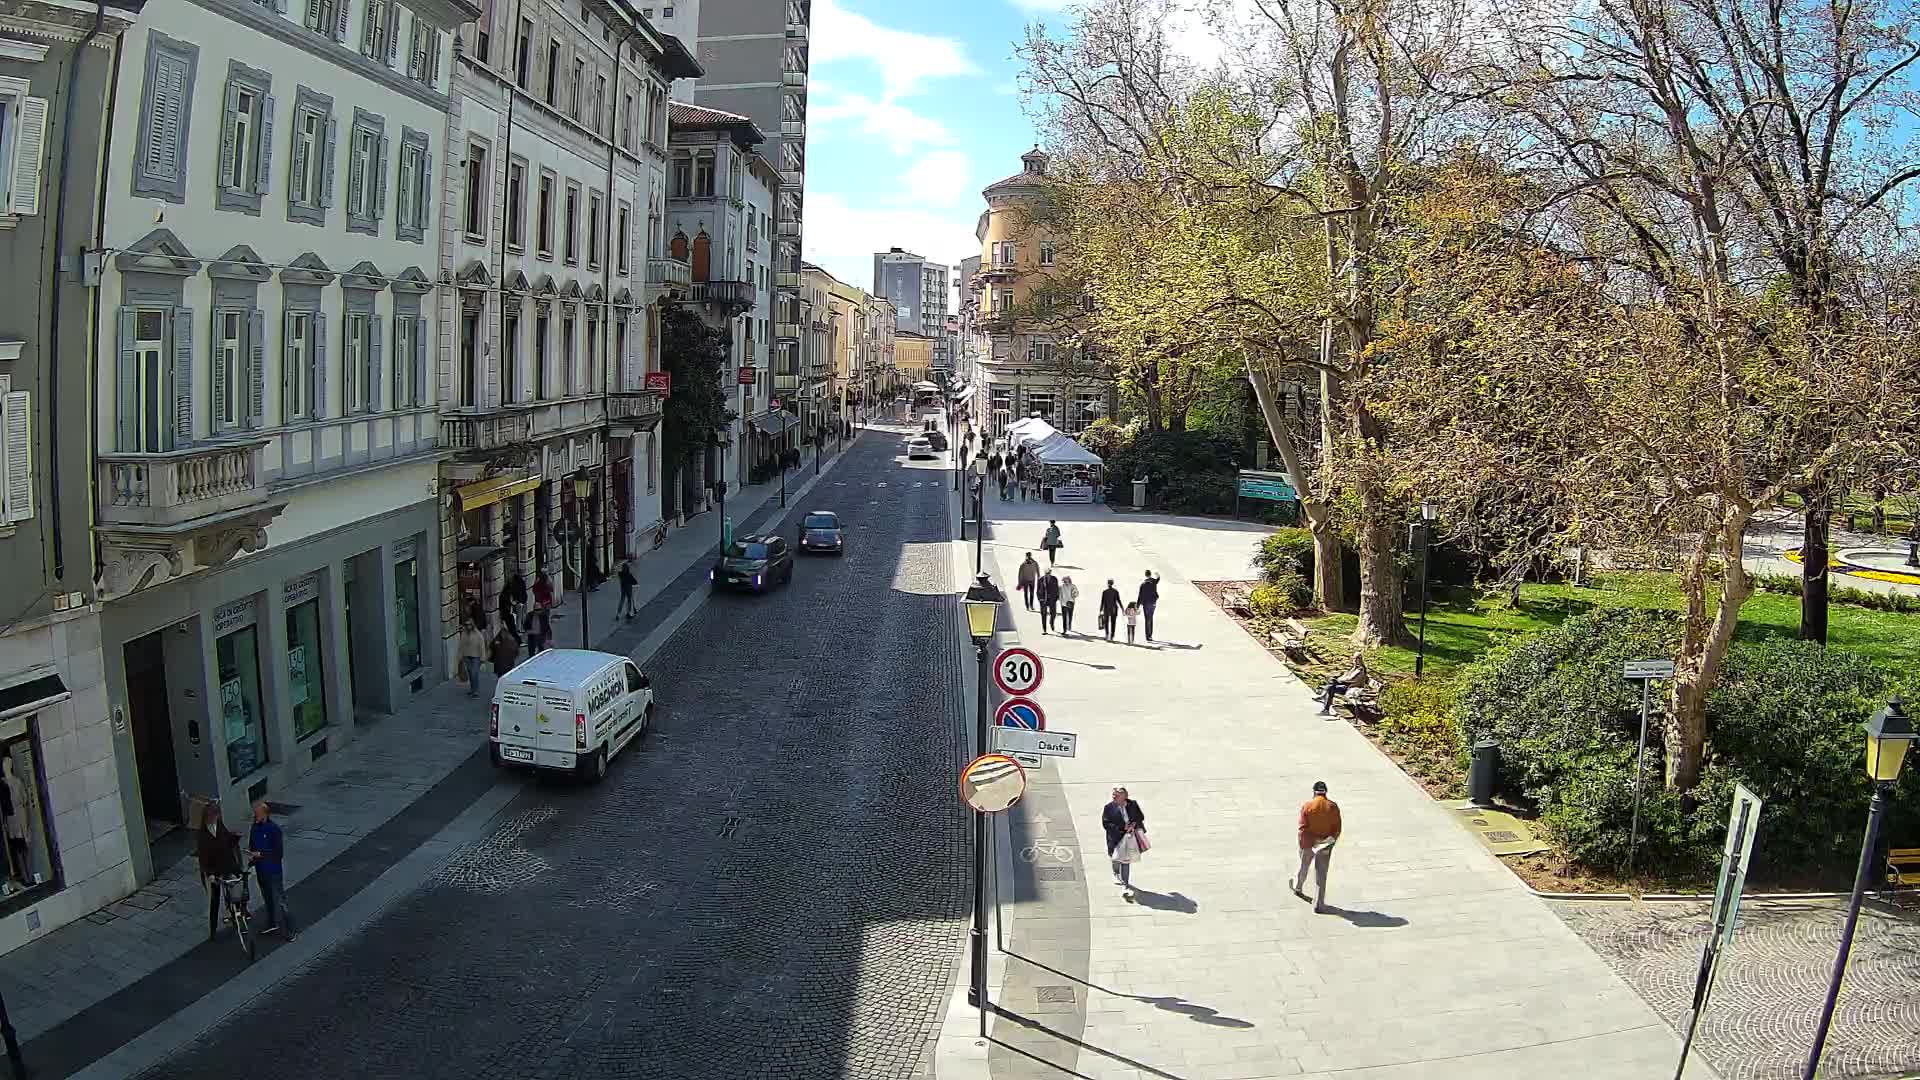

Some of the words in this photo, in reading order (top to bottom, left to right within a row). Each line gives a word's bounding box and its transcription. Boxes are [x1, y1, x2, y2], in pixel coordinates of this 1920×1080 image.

[1005, 660, 1033, 683] 30
[587, 679, 625, 716] MOSCHION
[1038, 740, 1070, 752] Dante
